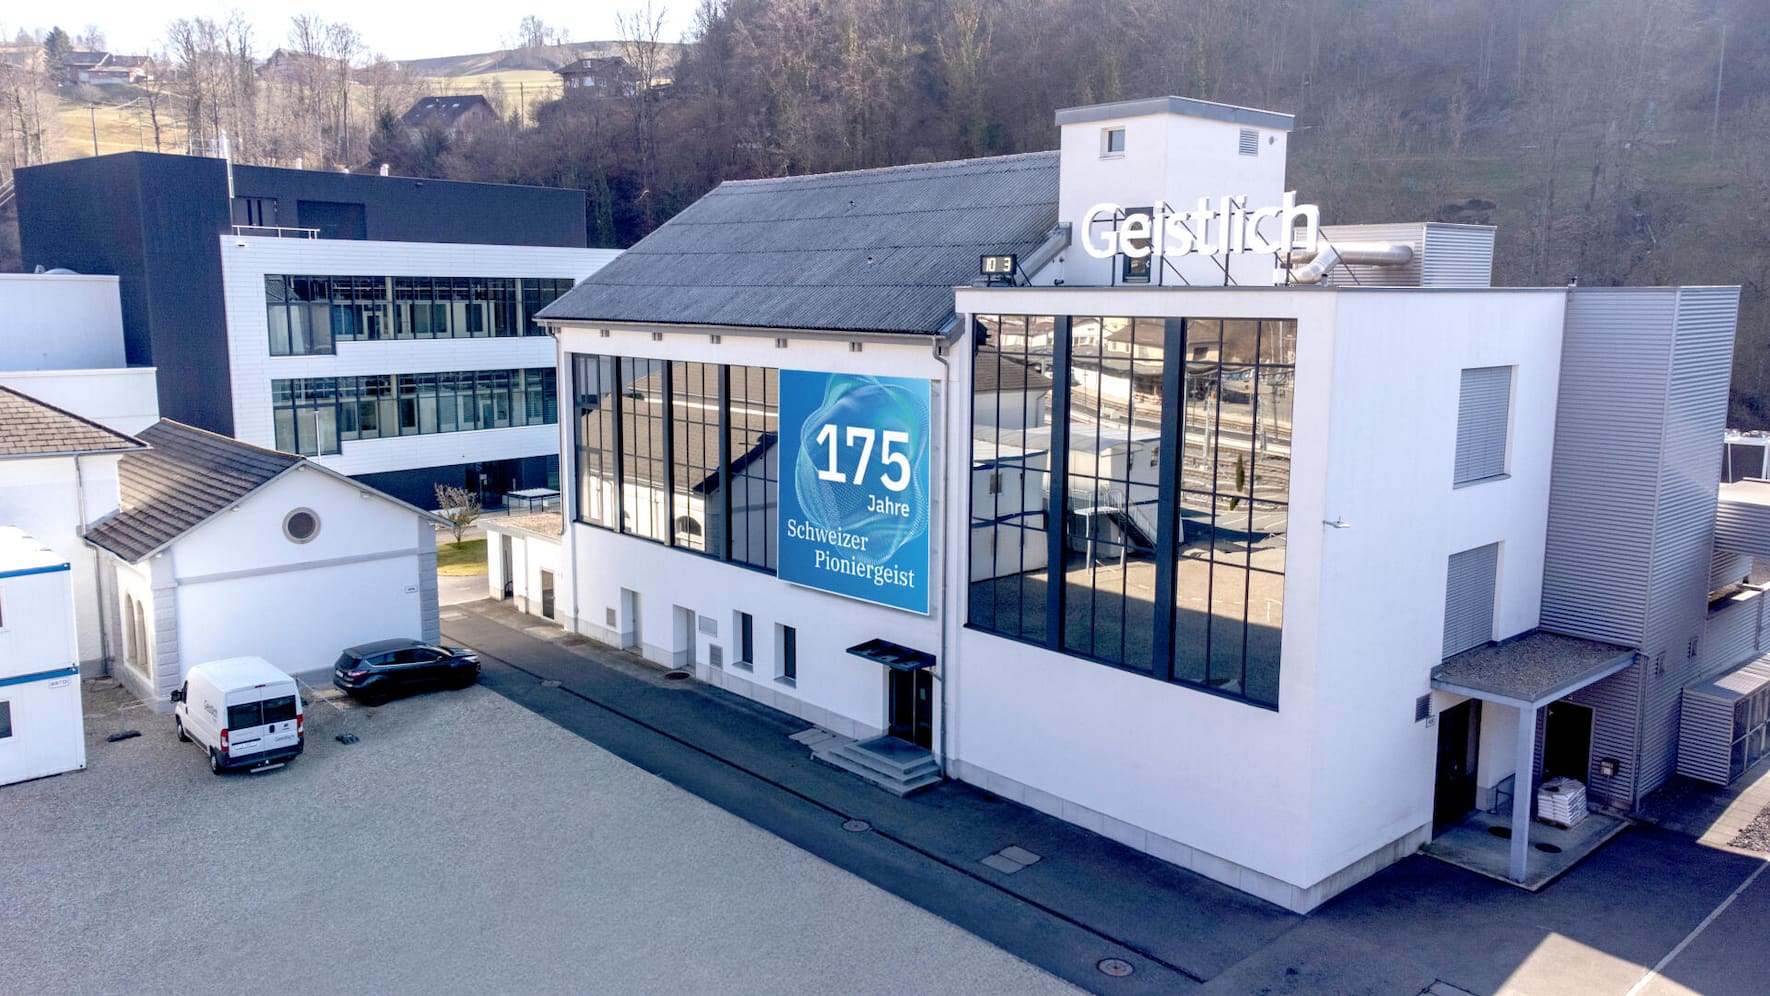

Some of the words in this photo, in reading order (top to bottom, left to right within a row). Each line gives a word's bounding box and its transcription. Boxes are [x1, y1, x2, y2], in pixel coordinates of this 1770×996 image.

[1081, 190, 1320, 259] Geistlich
[816, 423, 911, 492] 175
[867, 494, 910, 517] Jahre
[787, 519, 869, 551] Schweizer
[815, 550, 915, 588] Pioniergeist
